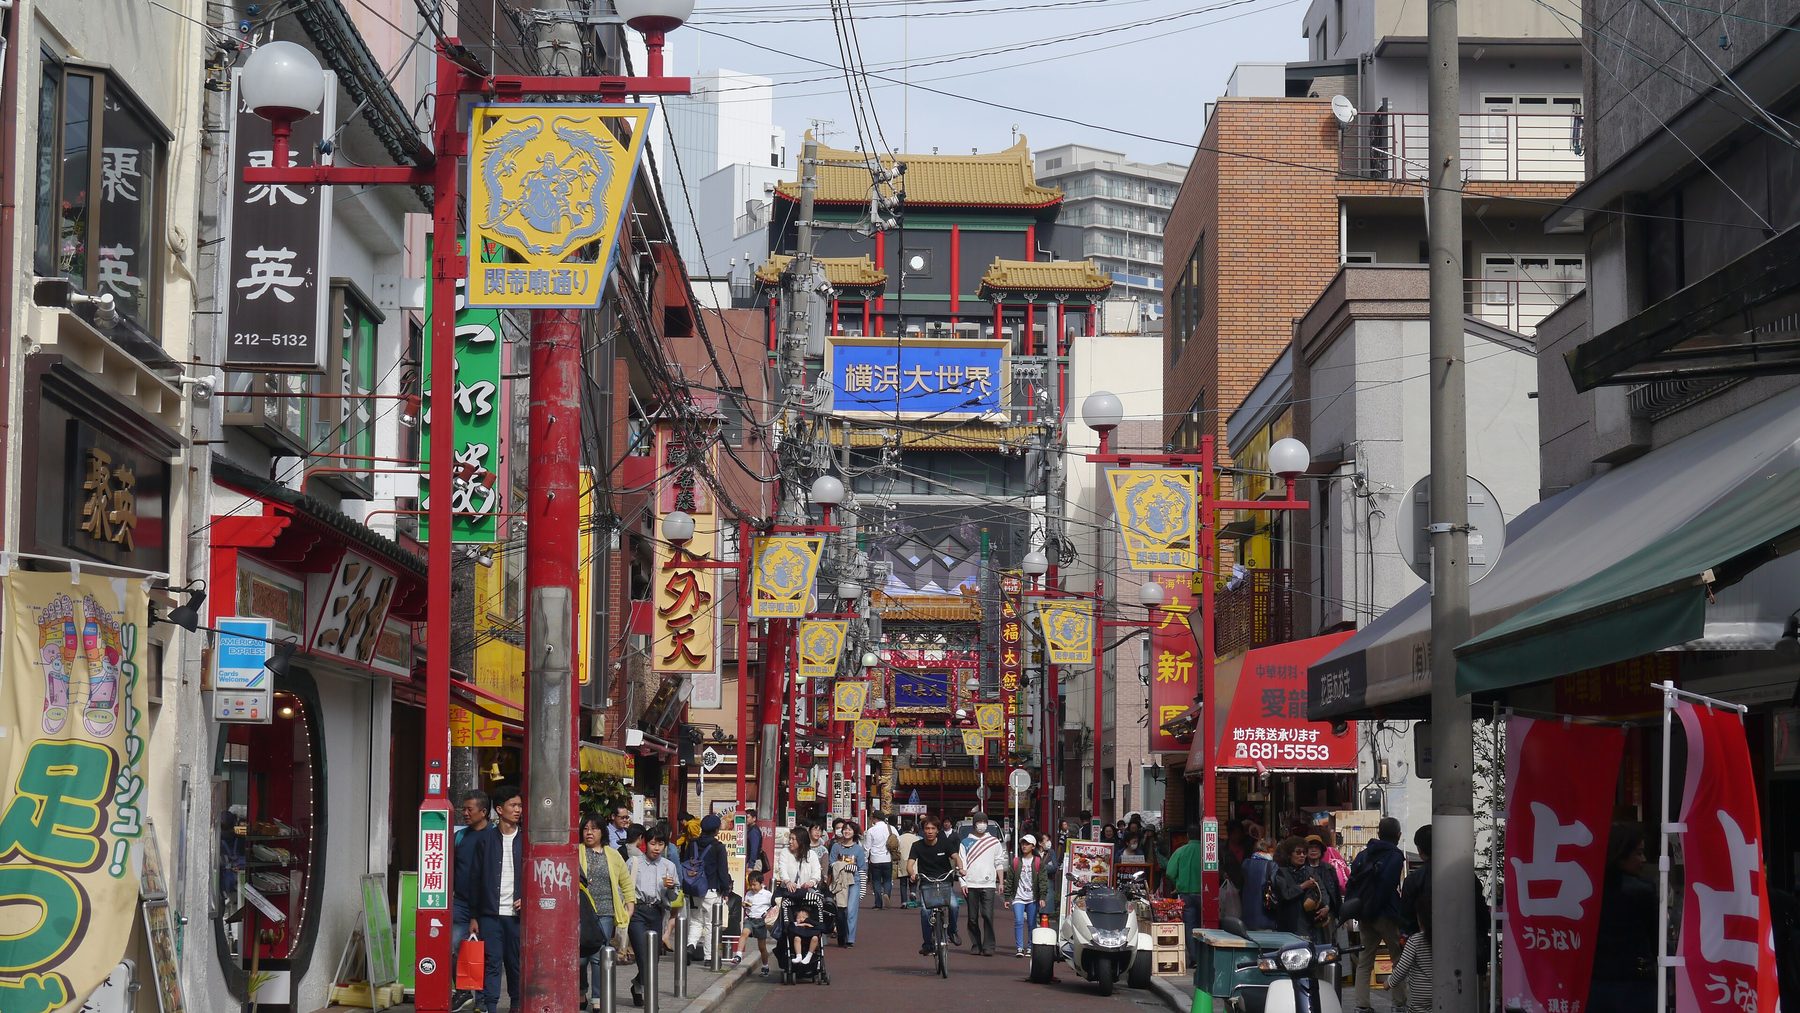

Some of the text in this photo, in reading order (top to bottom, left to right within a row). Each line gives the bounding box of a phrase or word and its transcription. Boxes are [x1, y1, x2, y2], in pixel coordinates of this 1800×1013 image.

[484, 268, 590, 295] 関帝廟通り
[234, 333, 308, 346] 212-5132
[845, 364, 992, 394] 横浜大世界
[220, 638, 264, 646] AMERICAN
[228, 647, 266, 655] EXPRESS
[1233, 728, 1320, 742] 地方発送承ります
[1249, 743, 1330, 760] 681-5553
[1205, 833, 1215, 862] 関帝廟
[424, 832, 444, 890] 関帝廟
[1510, 802, 1594, 920] 占
[1522, 926, 1581, 950] うらない
